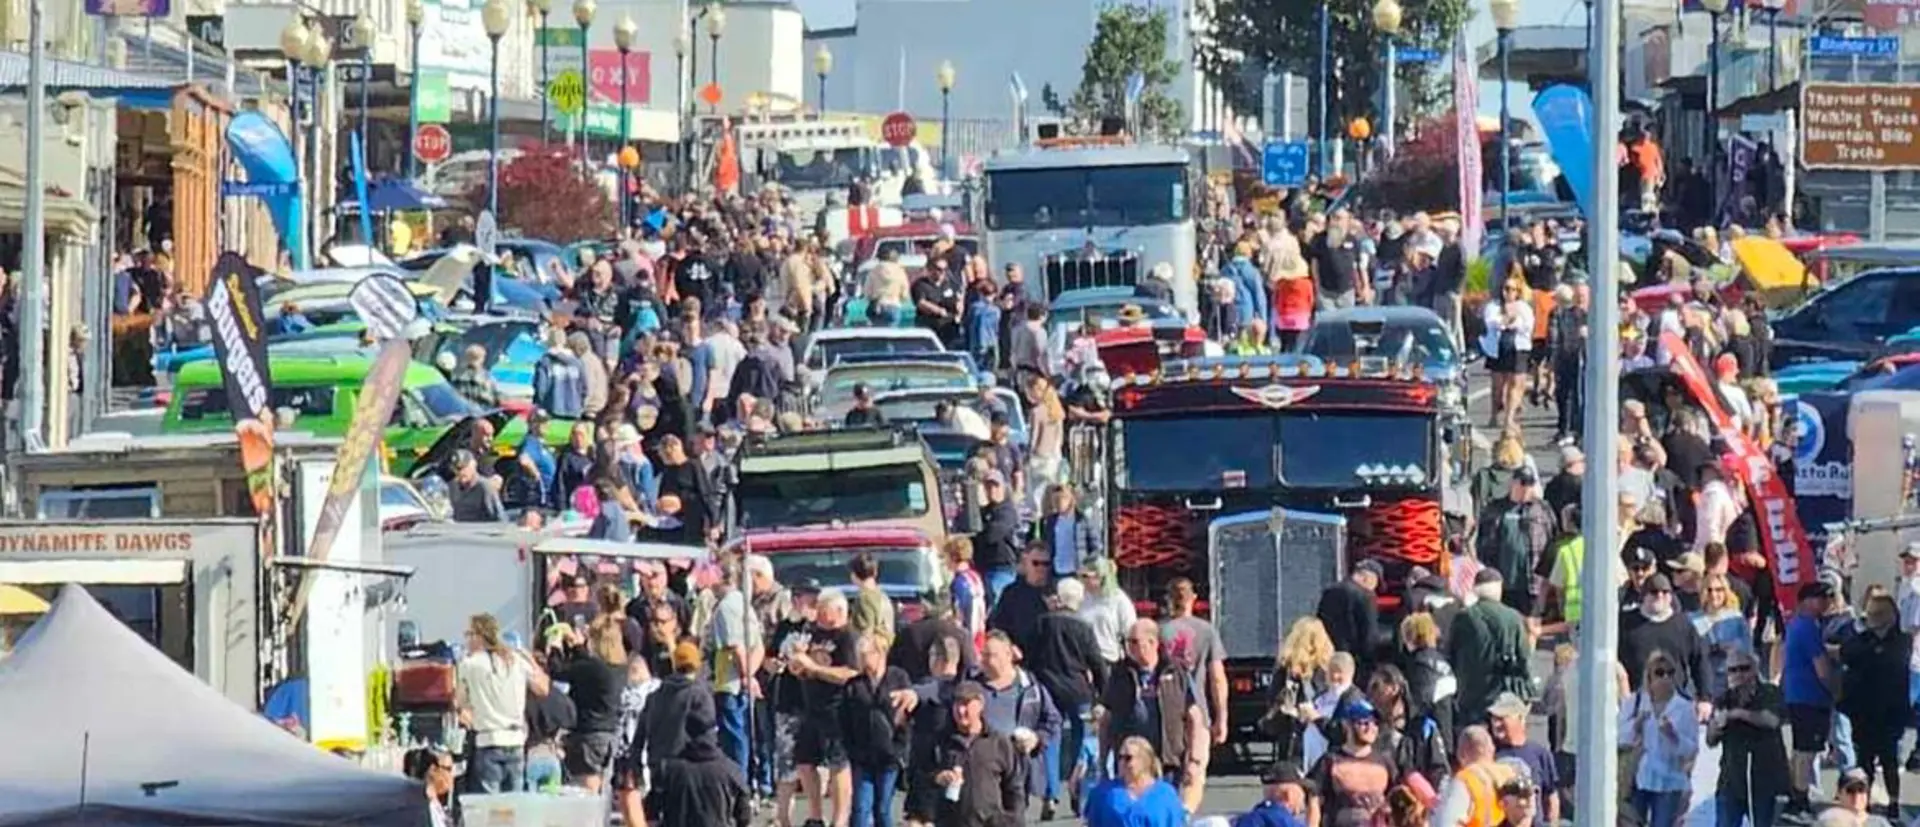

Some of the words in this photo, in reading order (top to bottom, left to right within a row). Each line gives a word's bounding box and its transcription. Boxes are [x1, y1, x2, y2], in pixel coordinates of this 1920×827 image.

[1807, 109, 1862, 128] Walking
[885, 121, 914, 138] STOP
[1807, 127, 1875, 142] Mountain
[416, 133, 446, 150] STOP
[1834, 143, 1885, 159] Tracks
[208, 277, 267, 416] Burgers
[115, 533, 192, 551] DAWGS
